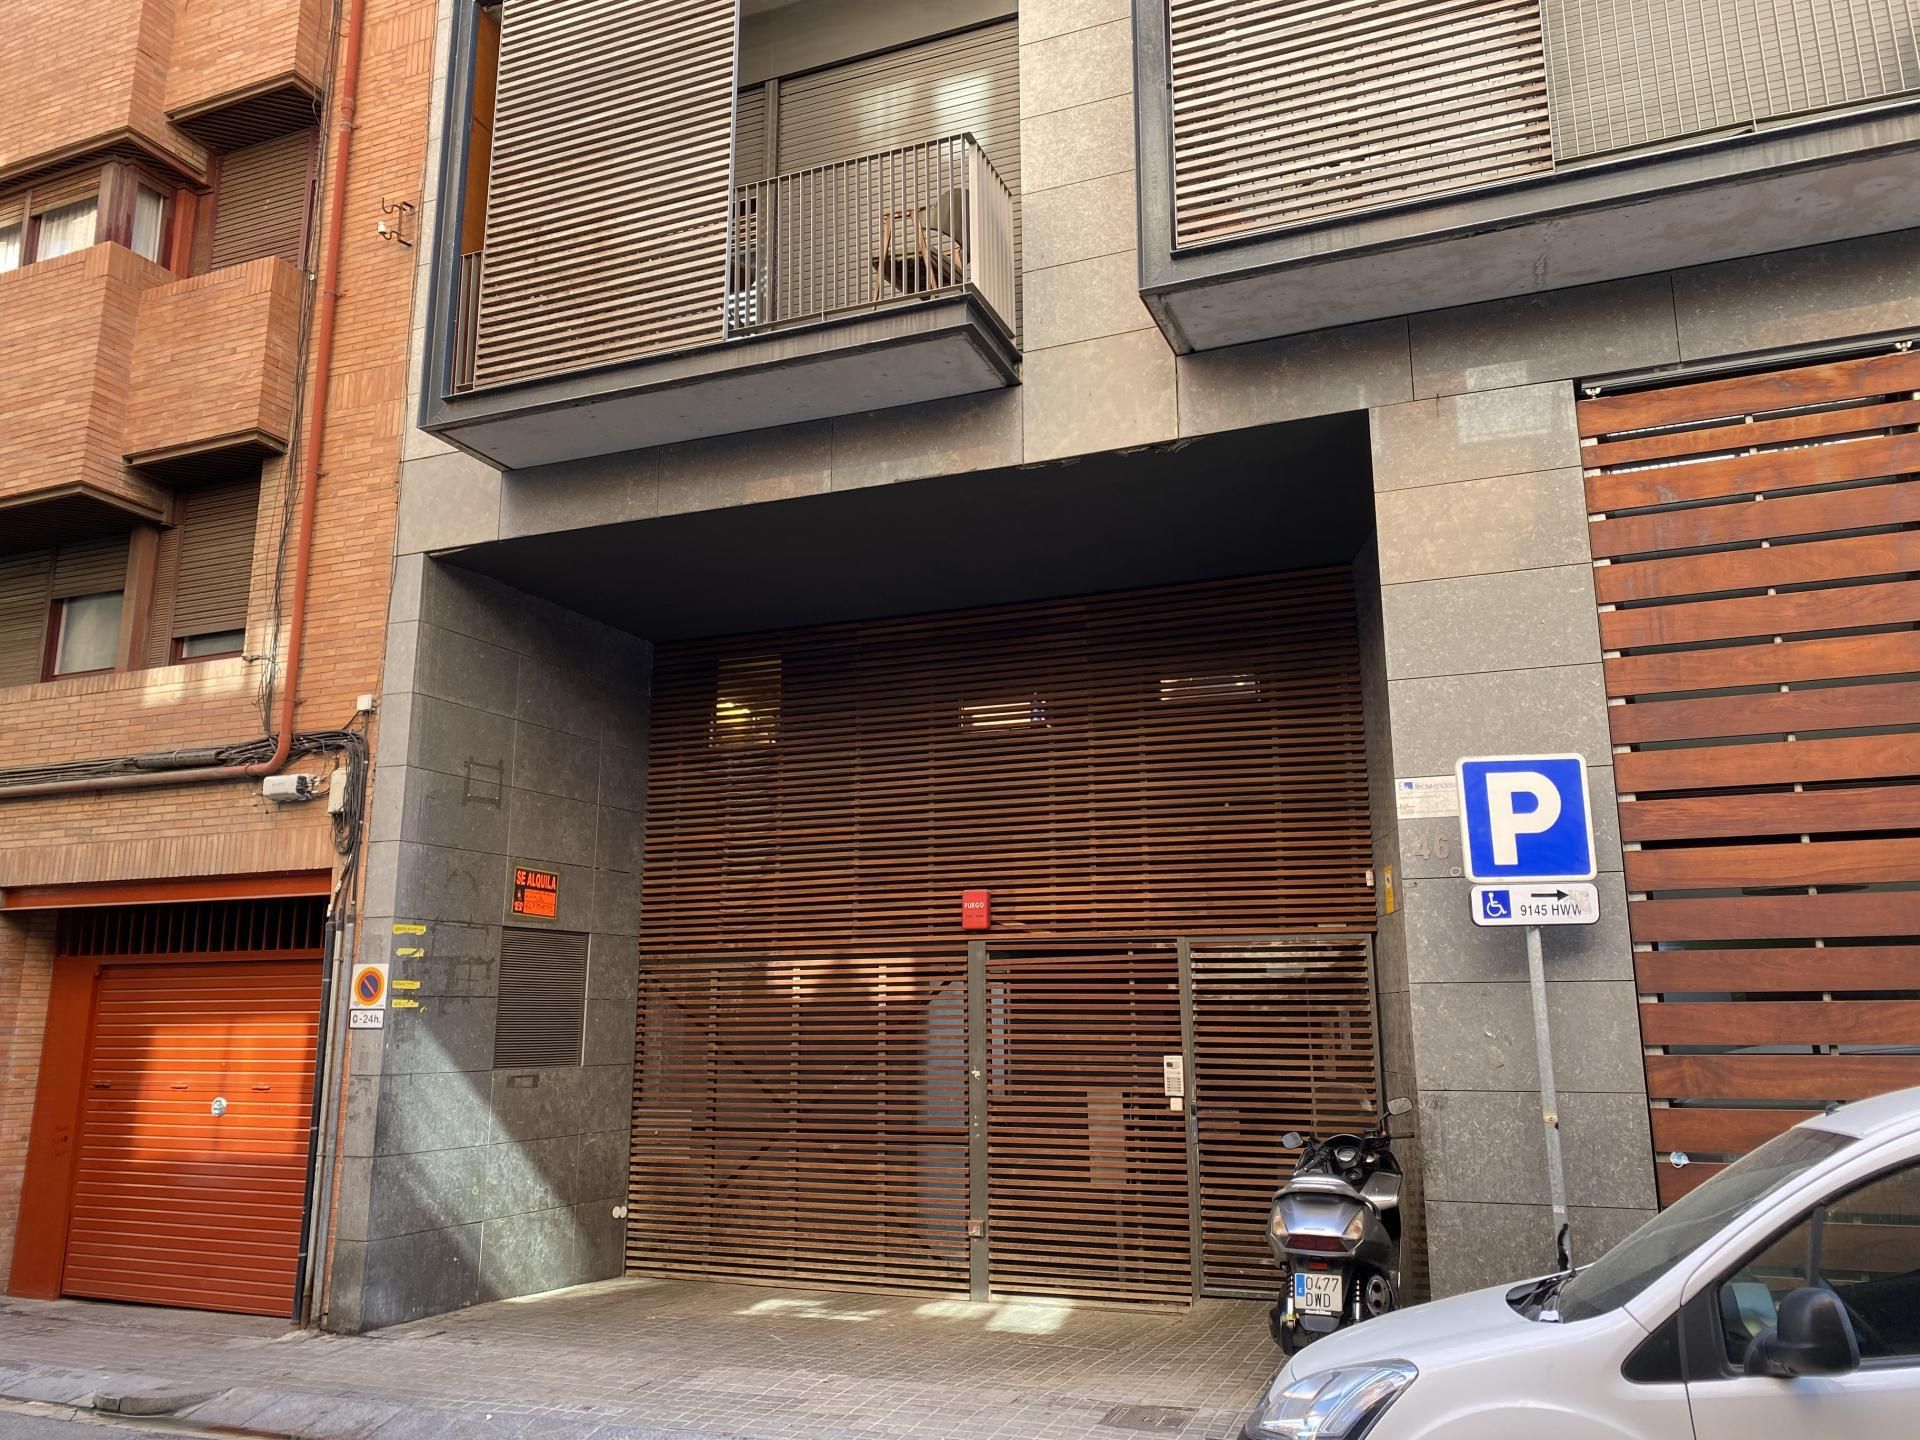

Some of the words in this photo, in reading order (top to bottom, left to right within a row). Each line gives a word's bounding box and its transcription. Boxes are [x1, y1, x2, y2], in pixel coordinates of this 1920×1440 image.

[1486, 771, 1562, 866] P
[1414, 832, 1450, 860] 46
[516, 870, 526, 885] SE
[527, 872, 556, 889] ALQUILA
[1520, 904, 1547, 916] 9145
[1305, 1276, 1339, 1292] 0477
[1305, 1292, 1331, 1308] DWD
